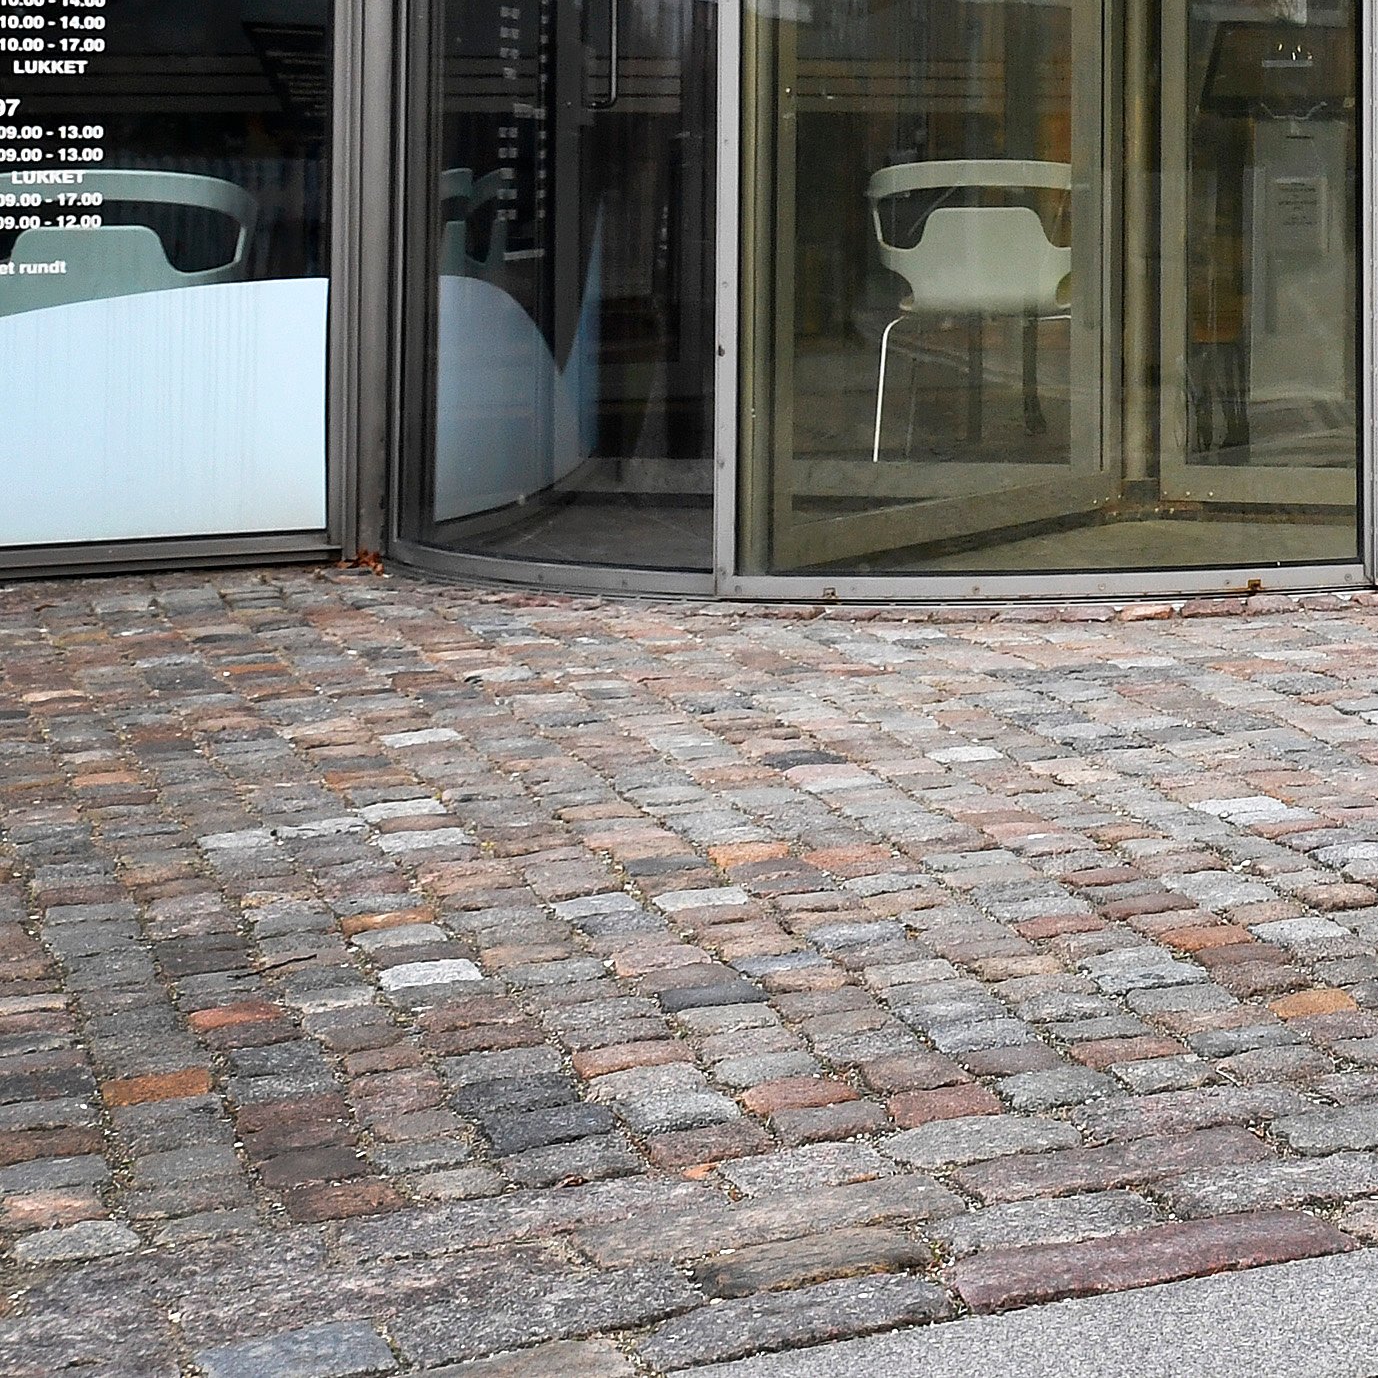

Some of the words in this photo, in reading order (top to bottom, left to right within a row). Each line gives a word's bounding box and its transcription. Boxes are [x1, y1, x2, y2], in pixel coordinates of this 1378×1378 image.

[0, 16, 44, 28] 10.00
[60, 16, 105, 29] 14.00
[0, 38, 44, 51] 10.00
[60, 39, 105, 51] 17.00
[14, 60, 88, 73] LUKKET
[59, 126, 103, 138] 13.00
[58, 148, 103, 161] 13.00
[11, 171, 86, 185] LUKKET
[56, 192, 103, 206] 17.00
[56, 214, 102, 229] 12.00
[19, 260, 67, 275] rundt
